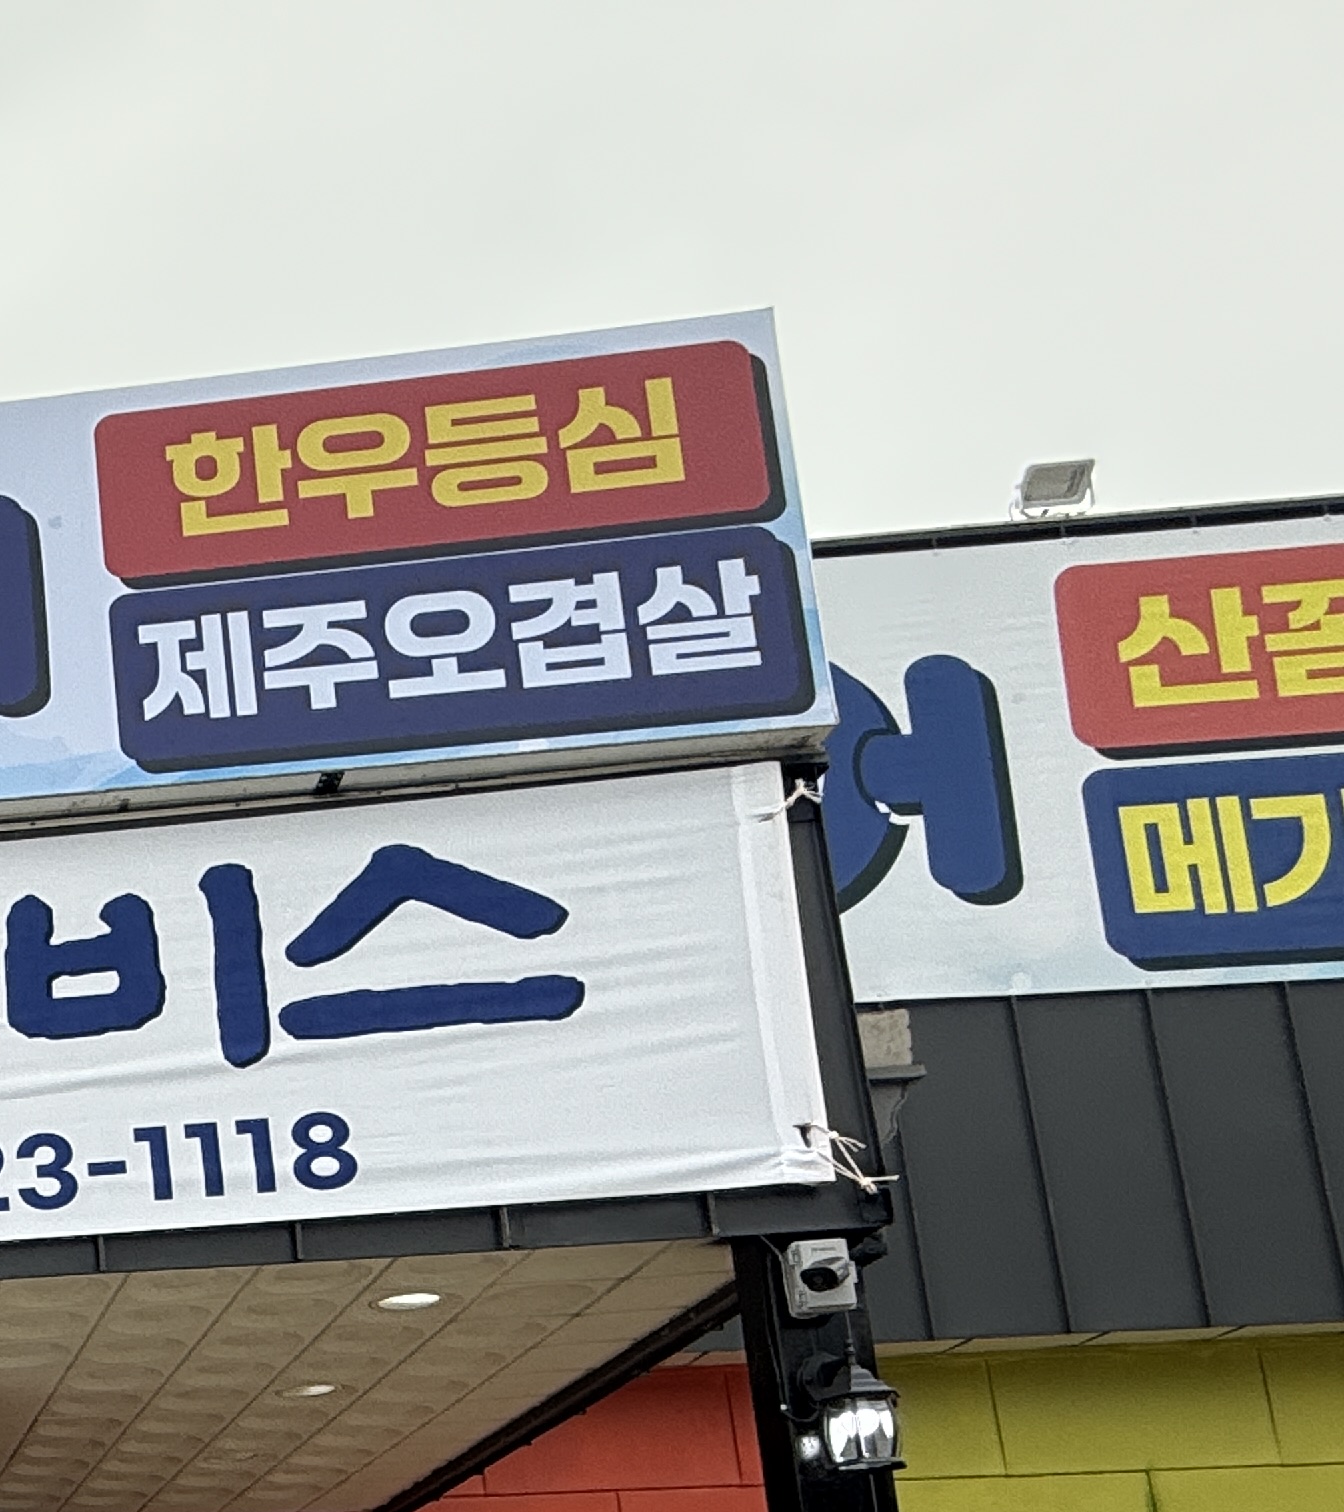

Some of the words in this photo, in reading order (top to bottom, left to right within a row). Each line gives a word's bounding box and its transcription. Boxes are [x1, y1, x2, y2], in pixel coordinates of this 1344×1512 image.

[165, 376, 687, 538] 한우등심
[138, 557, 763, 722] 제주오겹살
[1118, 792, 1344, 916] 메기
